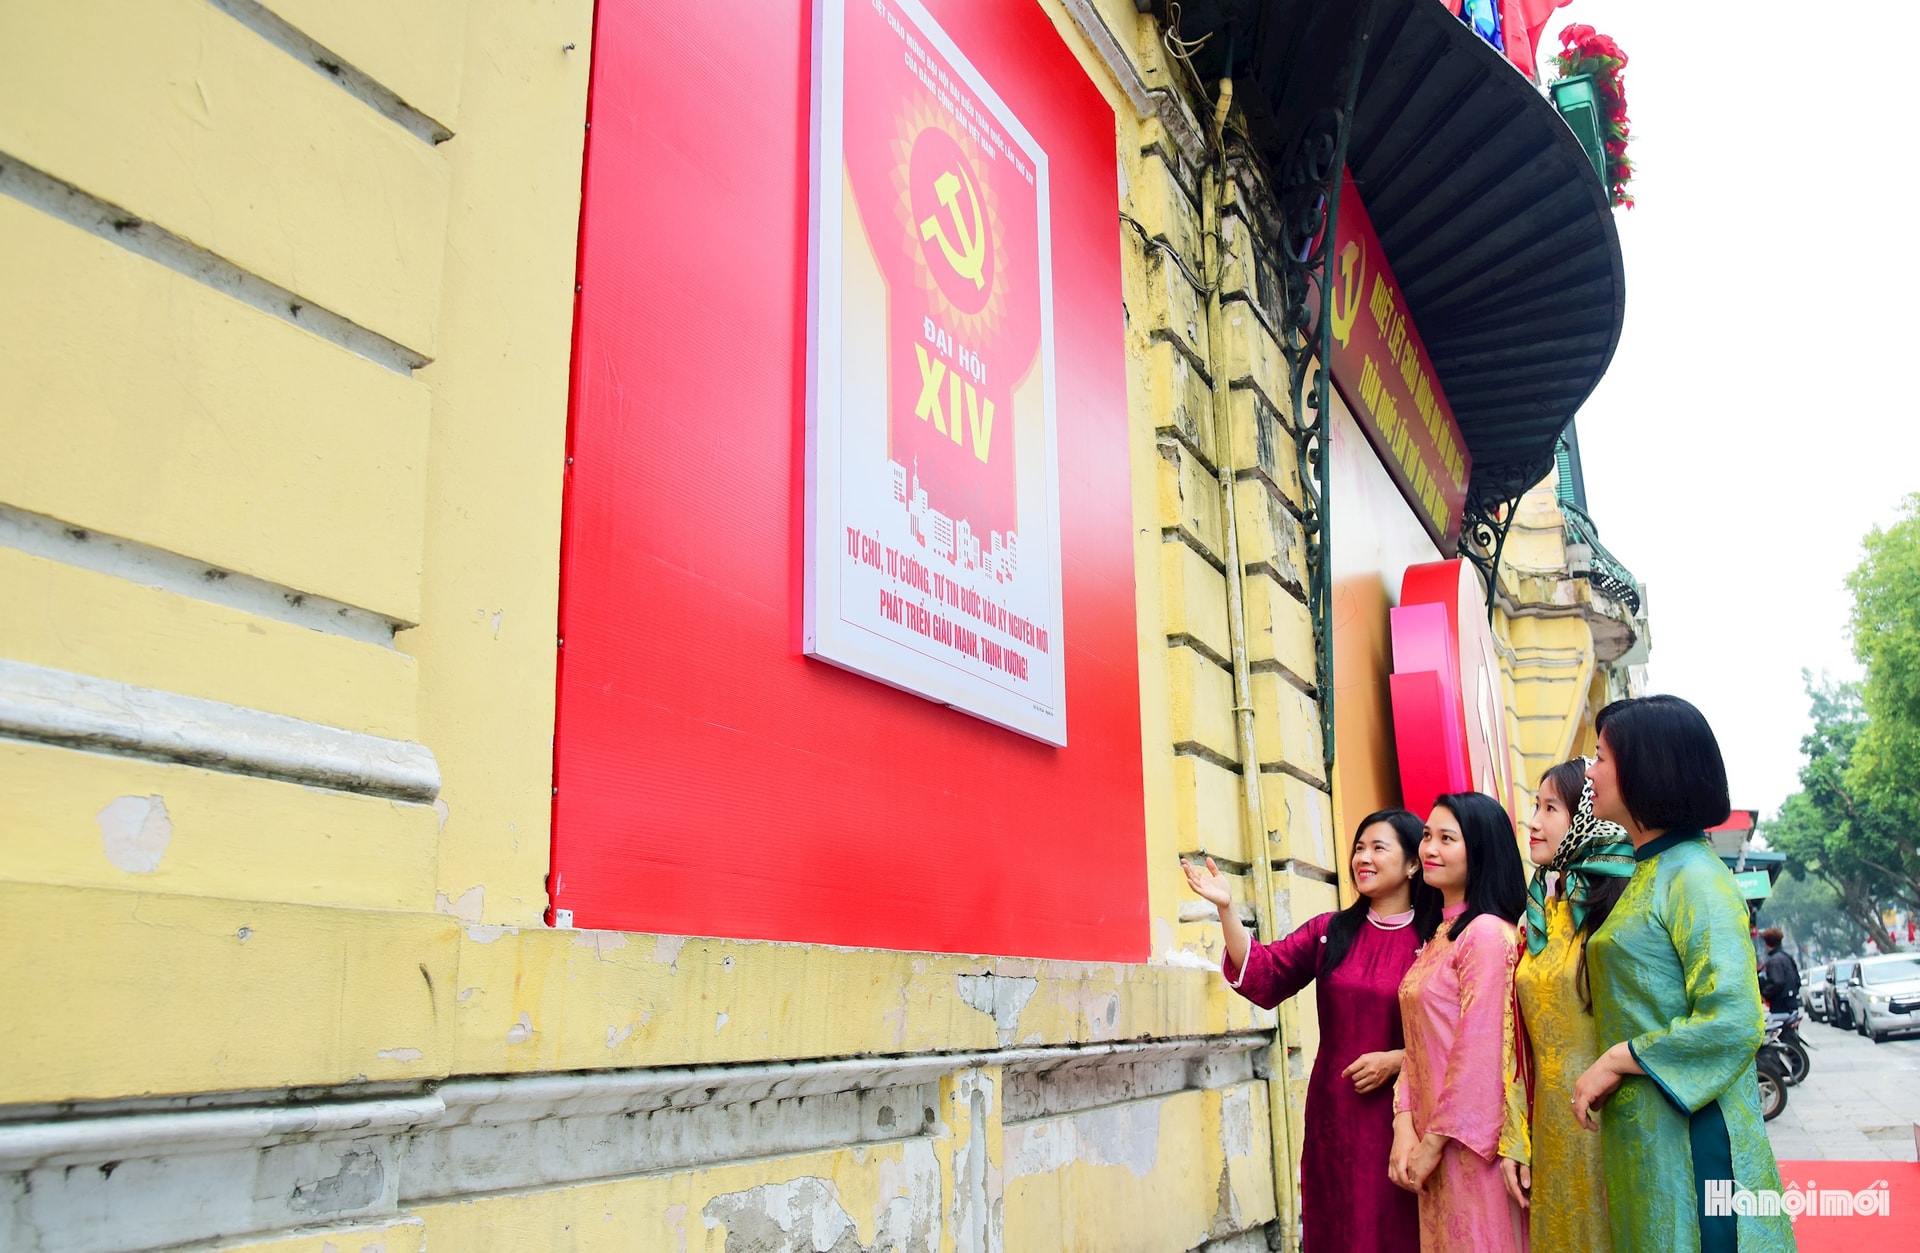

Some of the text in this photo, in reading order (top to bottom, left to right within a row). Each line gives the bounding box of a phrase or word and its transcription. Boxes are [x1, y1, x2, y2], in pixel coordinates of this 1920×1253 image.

[923, 315, 987, 385] ĐẠI HỘI
[1369, 271, 1395, 340] NHIỆT
[1387, 311, 1407, 366] LIỆT
[914, 341, 995, 464] XIV
[1358, 352, 1382, 416] TOÀN
[846, 526, 861, 565] TỰ
[861, 529, 884, 576] CHỦ,
[885, 546, 899, 584] TỰ
[899, 553, 932, 599] CƯỜNG,
[933, 572, 945, 607] TỰ
[945, 578, 959, 609] TIN
[960, 585, 981, 620] BƯỚC
[982, 595, 997, 628] VÀO
[1008, 611, 1036, 648] NGUYÊN
[1036, 623, 1049, 655] MỚI
[879, 588, 1029, 682] PHÁT TRIỂN GIÀU MẠNH, THỊNH VƯỢNG!
